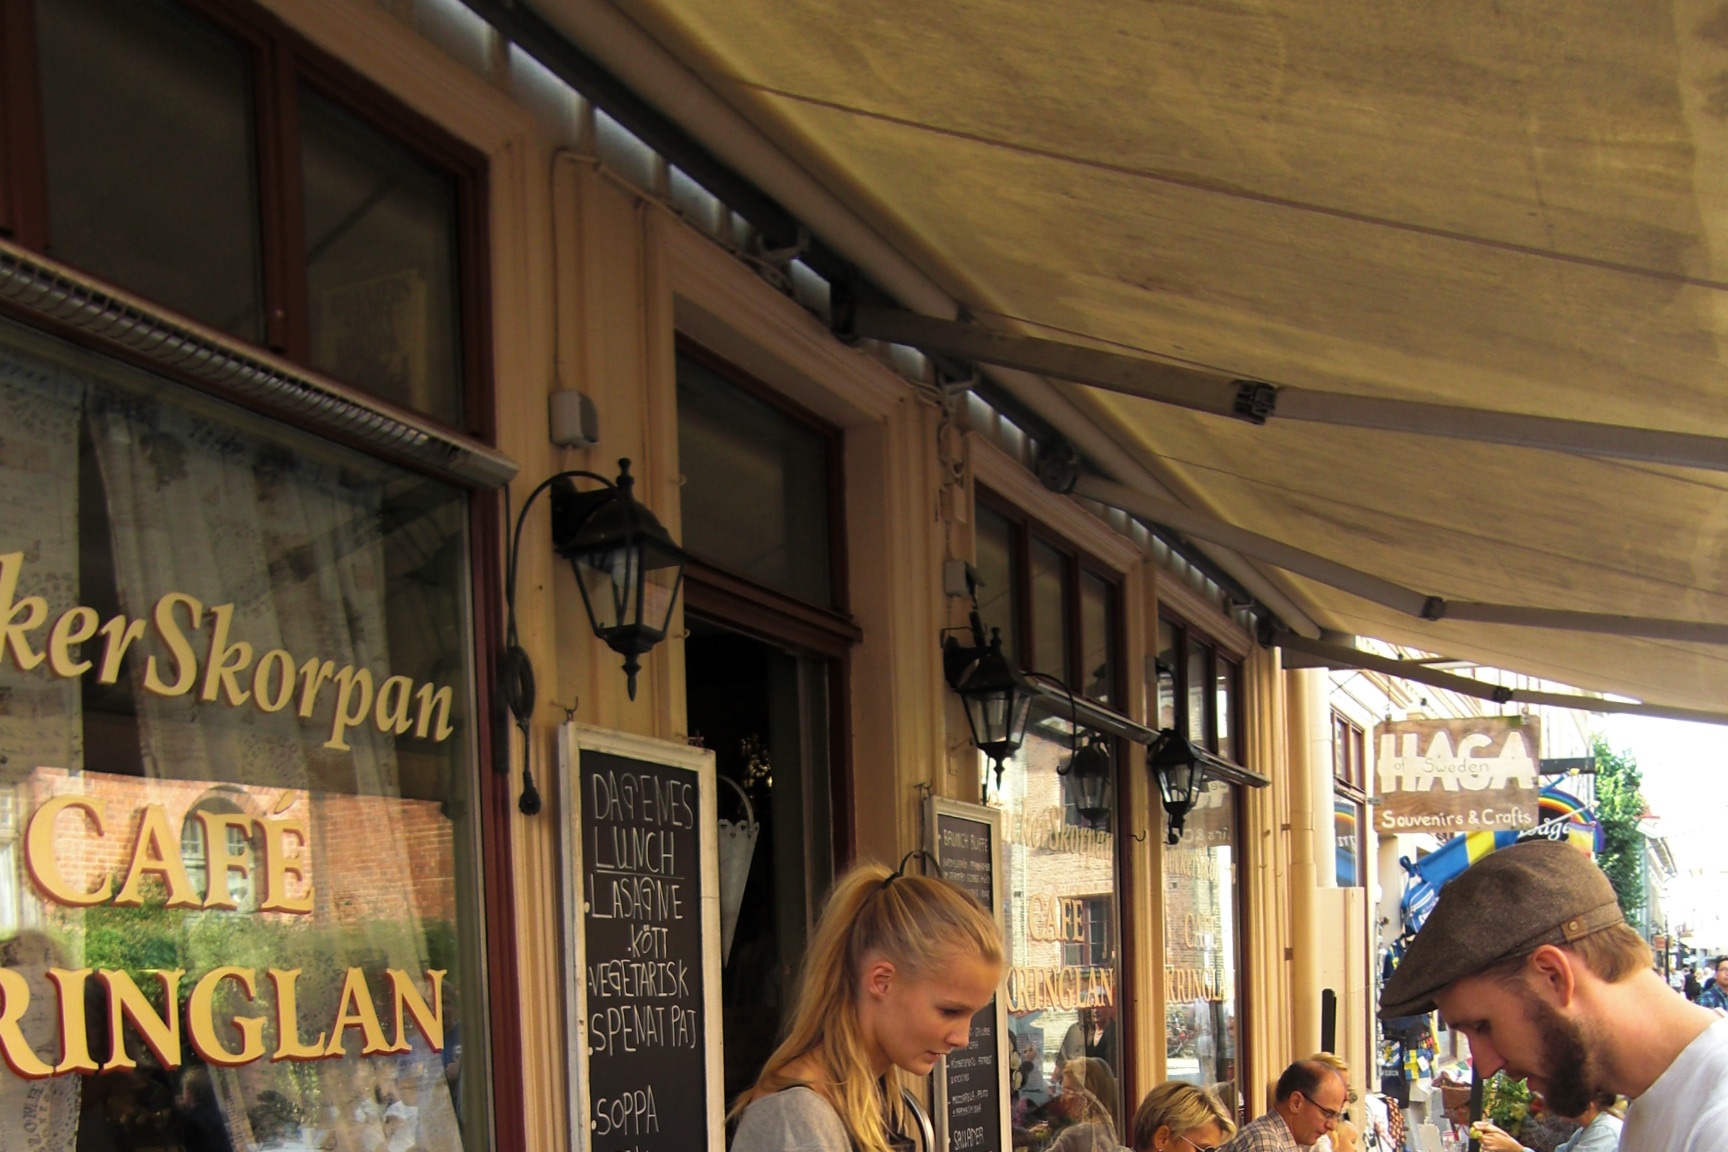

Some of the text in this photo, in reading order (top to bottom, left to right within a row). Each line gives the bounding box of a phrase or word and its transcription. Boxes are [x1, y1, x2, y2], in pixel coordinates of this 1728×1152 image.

[1378, 731, 1537, 793] HAGA
[1394, 757, 1489, 774] of Sweden
[593, 771, 694, 829] DAGENES
[1382, 807, 1532, 828] Souvenirs & Crafts
[24, 790, 314, 914] CAFÉ
[596, 827, 675, 875] LUNCH
[591, 873, 683, 921] LASAGNE
[592, 1004, 696, 1056] SPENAT PAJ
[597, 1085, 659, 1135] SOPPA
